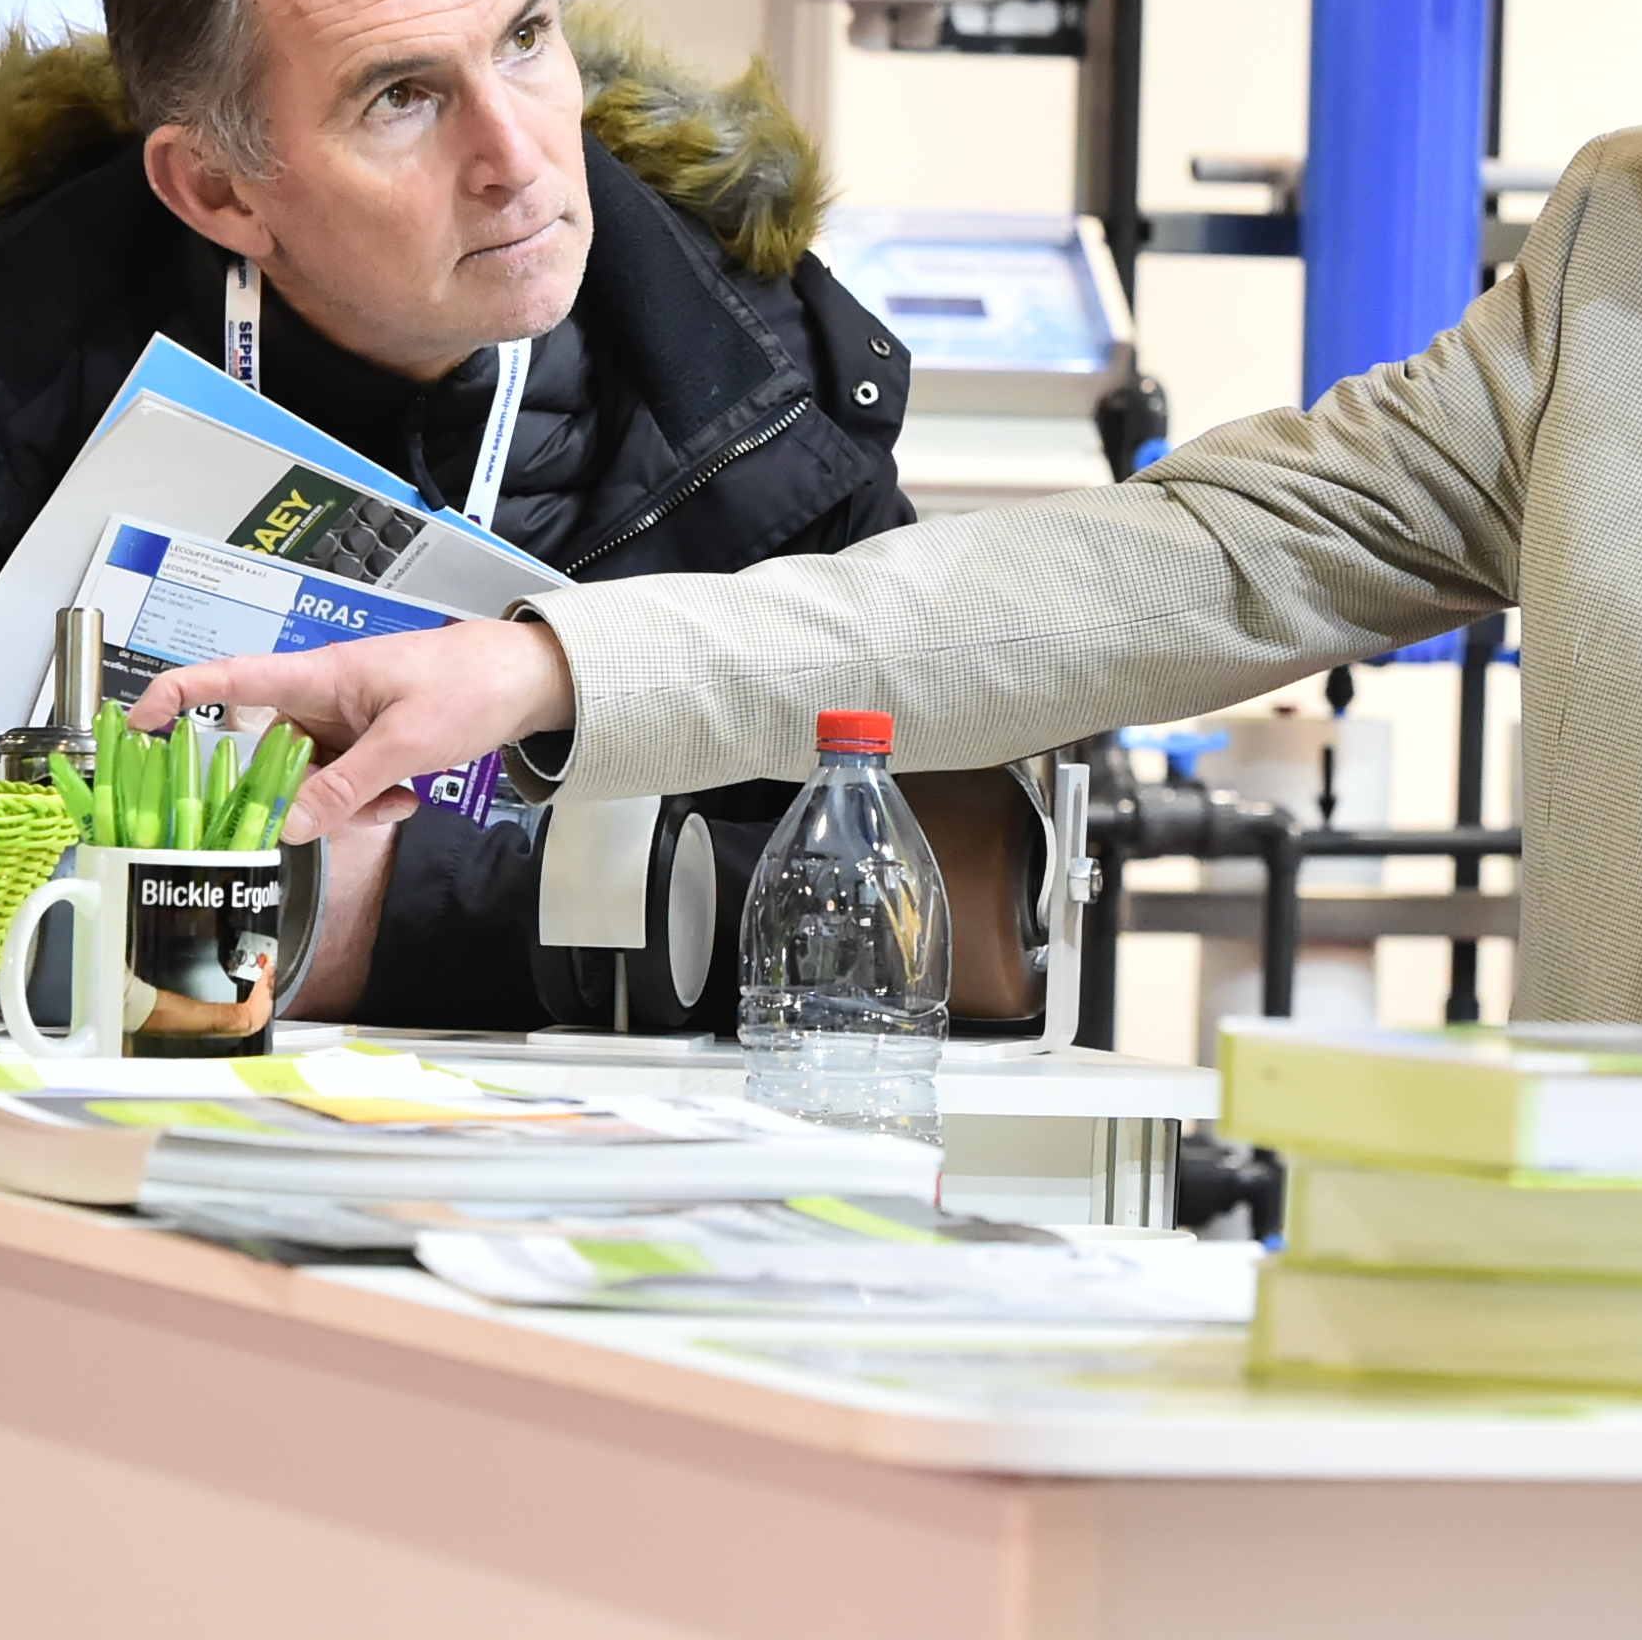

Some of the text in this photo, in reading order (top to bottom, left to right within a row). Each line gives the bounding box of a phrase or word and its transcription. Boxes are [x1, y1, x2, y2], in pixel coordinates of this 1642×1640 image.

[238, 321, 253, 381] SEPEM
[388, 539, 430, 583] industrielle
[117, 649, 131, 659] de
[131, 653, 160, 666] toutes
[141, 878, 225, 909] Blickle
